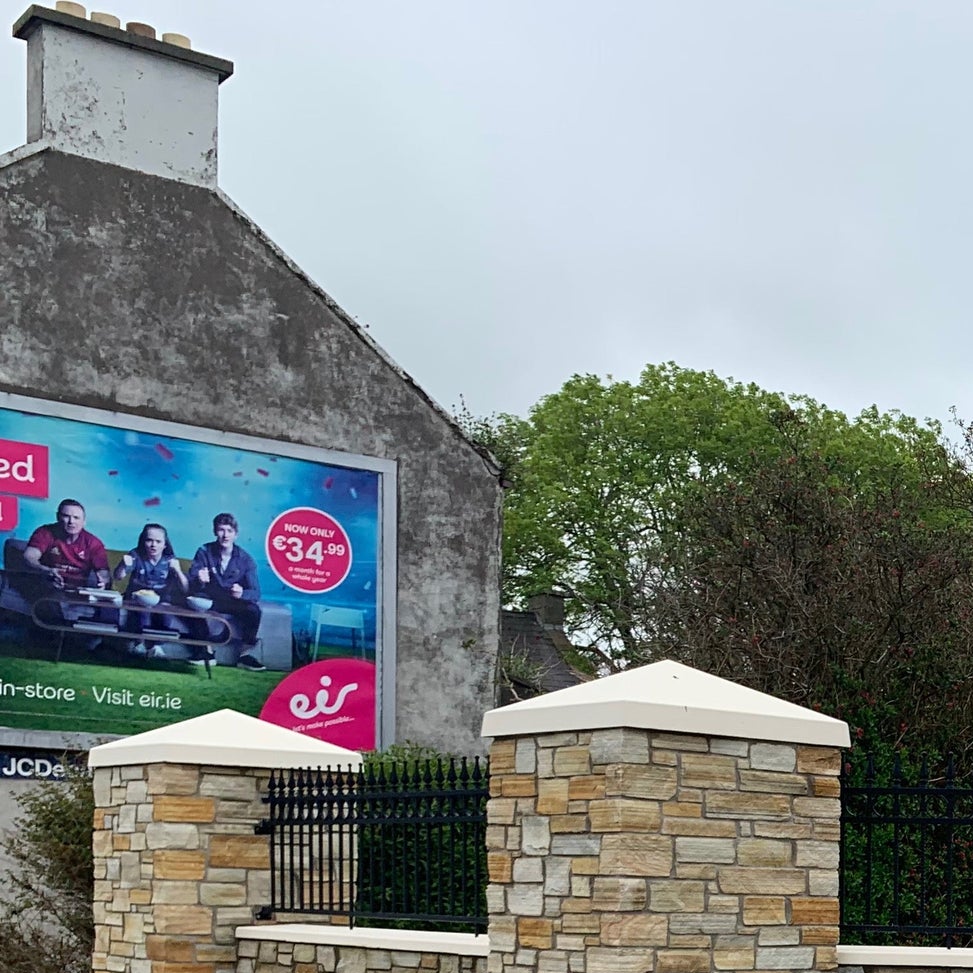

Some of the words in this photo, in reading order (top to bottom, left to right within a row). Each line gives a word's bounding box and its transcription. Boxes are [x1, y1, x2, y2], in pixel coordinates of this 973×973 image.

[284, 523, 308, 535] NOW
[310, 527, 335, 538] ONLY
[272, 535, 345, 566] €34.99
[0, 679, 76, 701] in-store
[92, 686, 134, 706] Visit
[139, 691, 182, 710] eir.ie
[289, 675, 358, 719] eir
[2, 757, 93, 779] JCDe
